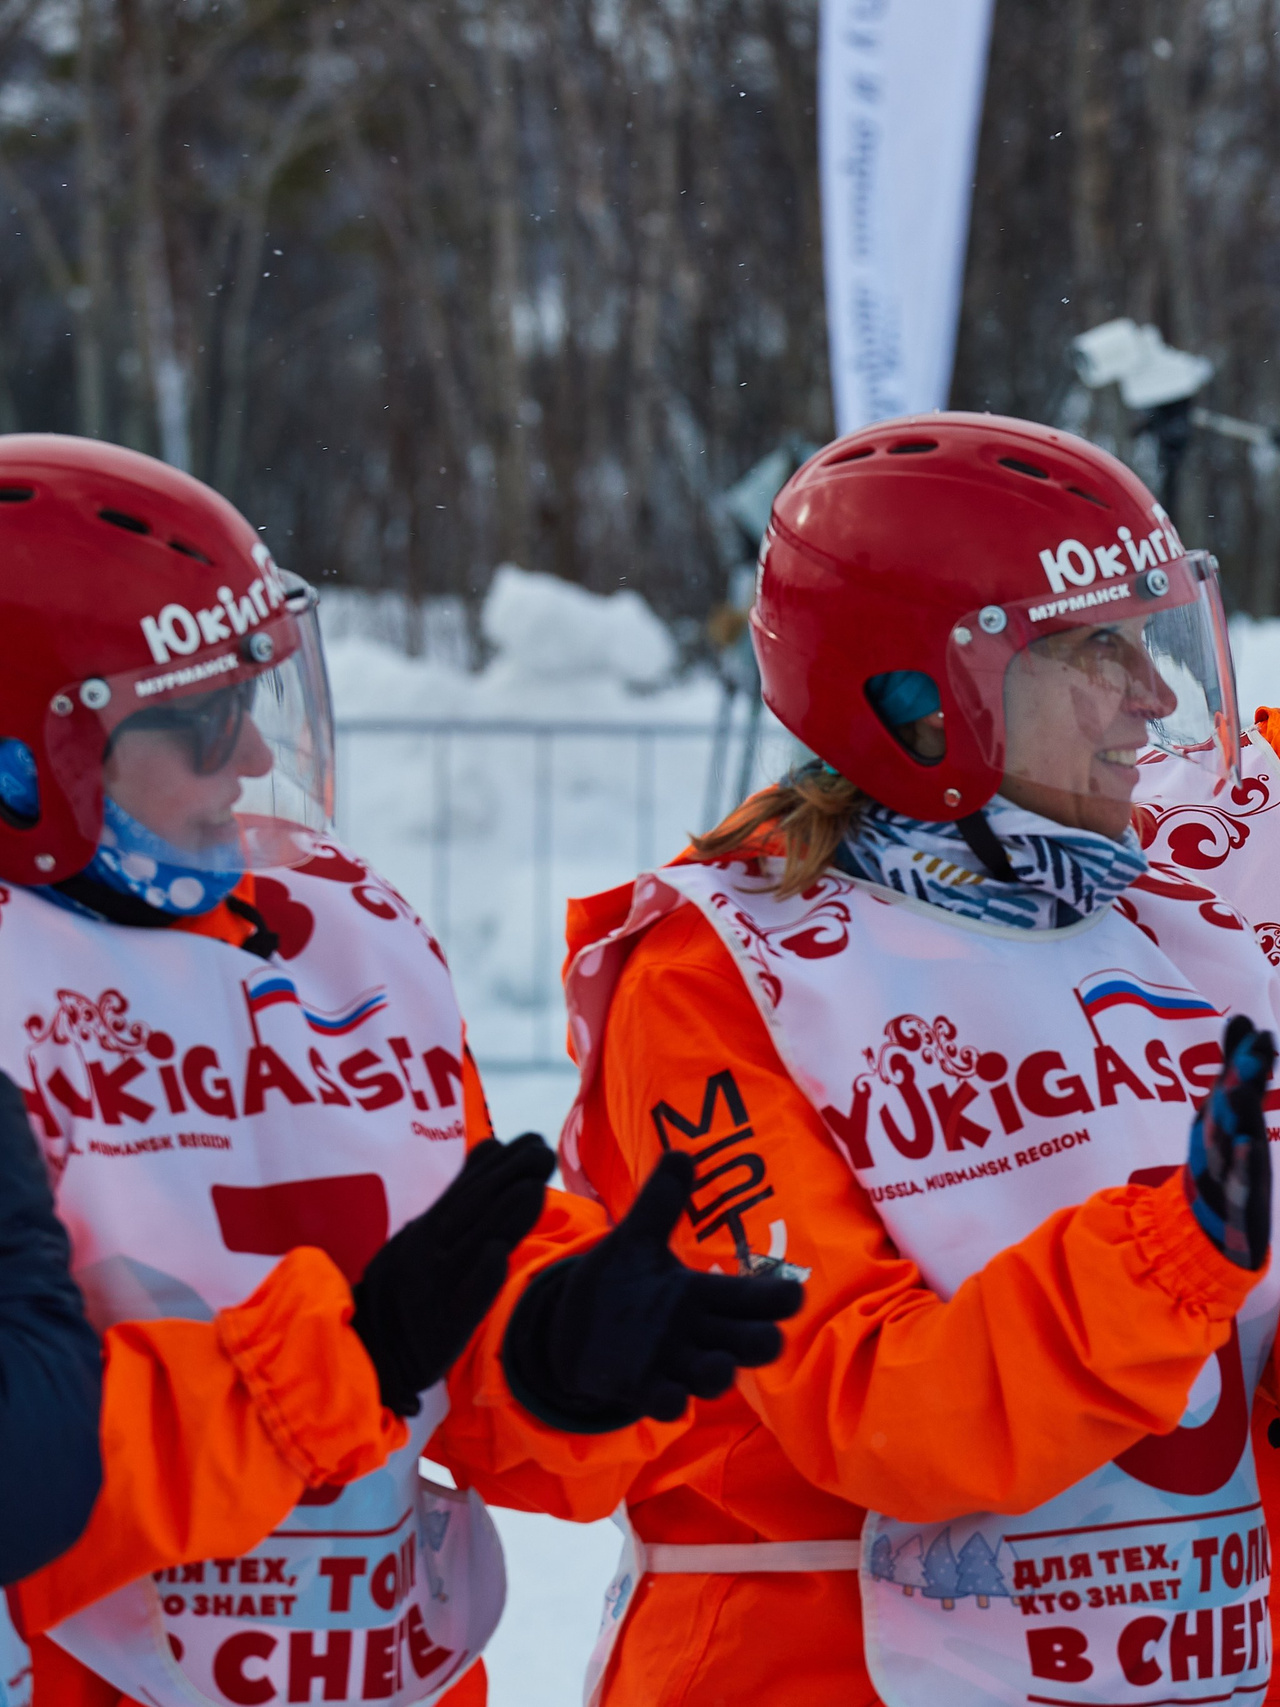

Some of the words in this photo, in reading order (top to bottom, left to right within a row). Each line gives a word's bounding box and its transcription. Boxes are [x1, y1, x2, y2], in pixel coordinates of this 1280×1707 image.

[1028, 583, 1132, 622] МУРМАНСК
[134, 653, 239, 697] МУРМАНСК
[925, 1156, 1012, 1191] MURMANSK
[1014, 1128, 1091, 1167] REGION
[213, 1558, 297, 1587] ТЕХ,
[1013, 1552, 1093, 1590] ДЛЯ
[1097, 1543, 1179, 1575] ТЕХ,
[193, 1594, 297, 1617] ЗНАЕТ
[1019, 1591, 1081, 1615] КТО
[1086, 1578, 1182, 1608] ЗНАЕТ
[1026, 1626, 1094, 1683] В
